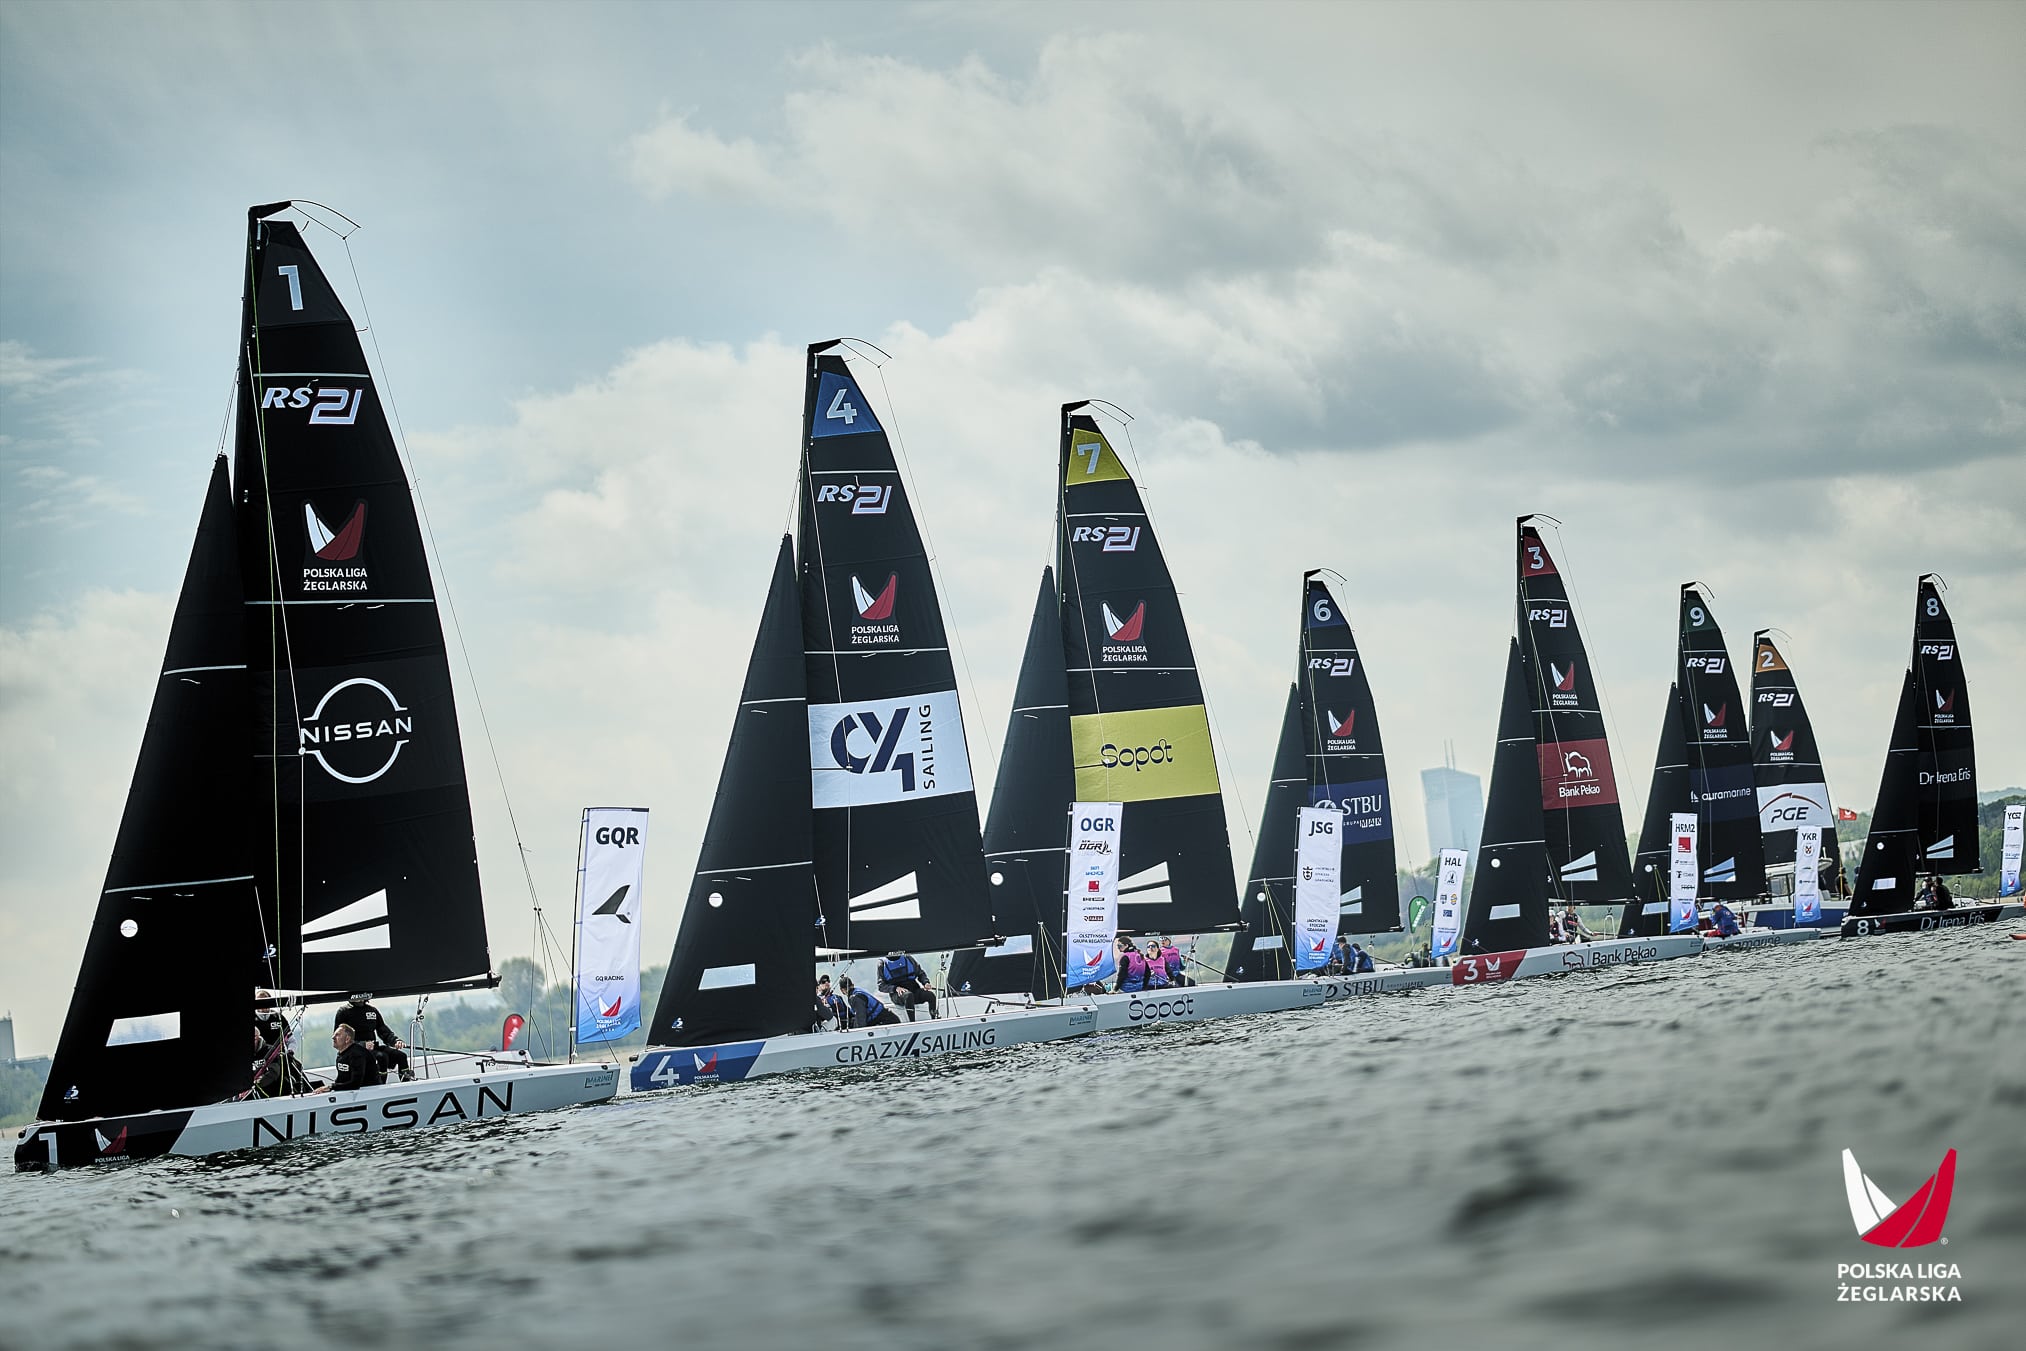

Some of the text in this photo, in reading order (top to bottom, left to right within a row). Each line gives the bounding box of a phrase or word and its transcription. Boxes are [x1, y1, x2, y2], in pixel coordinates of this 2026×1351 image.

[278, 264, 304, 310] 1
[826, 388, 857, 425] 4
[1076, 443, 1101, 474] 7
[1528, 546, 1544, 570] 3
[303, 568, 368, 578] POLSKA LIGA
[303, 579, 368, 591] ŻEGLARSKA
[1314, 599, 1332, 622] 6
[1926, 597, 1940, 616] 8
[1690, 606, 1704, 627] 9
[851, 624, 899, 634] POLSKA LIGA
[851, 634, 899, 644] ŻEGLARSKA
[1102, 645, 1147, 654] POLSKA LIGA
[1102, 653, 1148, 662] ŻEGLARSKA
[1760, 651, 1774, 667] 2
[300, 716, 412, 745] NISSAN
[919, 704, 936, 790] SAILING
[1101, 738, 1173, 772] Sopot
[1920, 767, 1971, 785] Dr Irena Eris
[1558, 784, 1600, 798] Bank Pekao
[1701, 786, 1751, 801] auramarine
[1341, 794, 1382, 816] STBU
[1771, 807, 1809, 823] PGE
[1081, 817, 1115, 832] OGR
[1309, 820, 1333, 836] JSG
[595, 826, 640, 849] GQR
[1801, 832, 1817, 840] YKR
[1444, 857, 1462, 867] HAL
[1857, 919, 1869, 935] 8
[1920, 916, 1937, 930] Dr
[1592, 945, 1657, 966] Bank Pekao
[1462, 959, 1479, 981] 3
[1342, 979, 1384, 997] STBU
[1128, 994, 1194, 1021] Sopot
[650, 1055, 680, 1086] 4
[253, 1081, 514, 1148] NISSAN
[38, 1132, 58, 1167] 1
[95, 1155, 117, 1163] POLSKA
